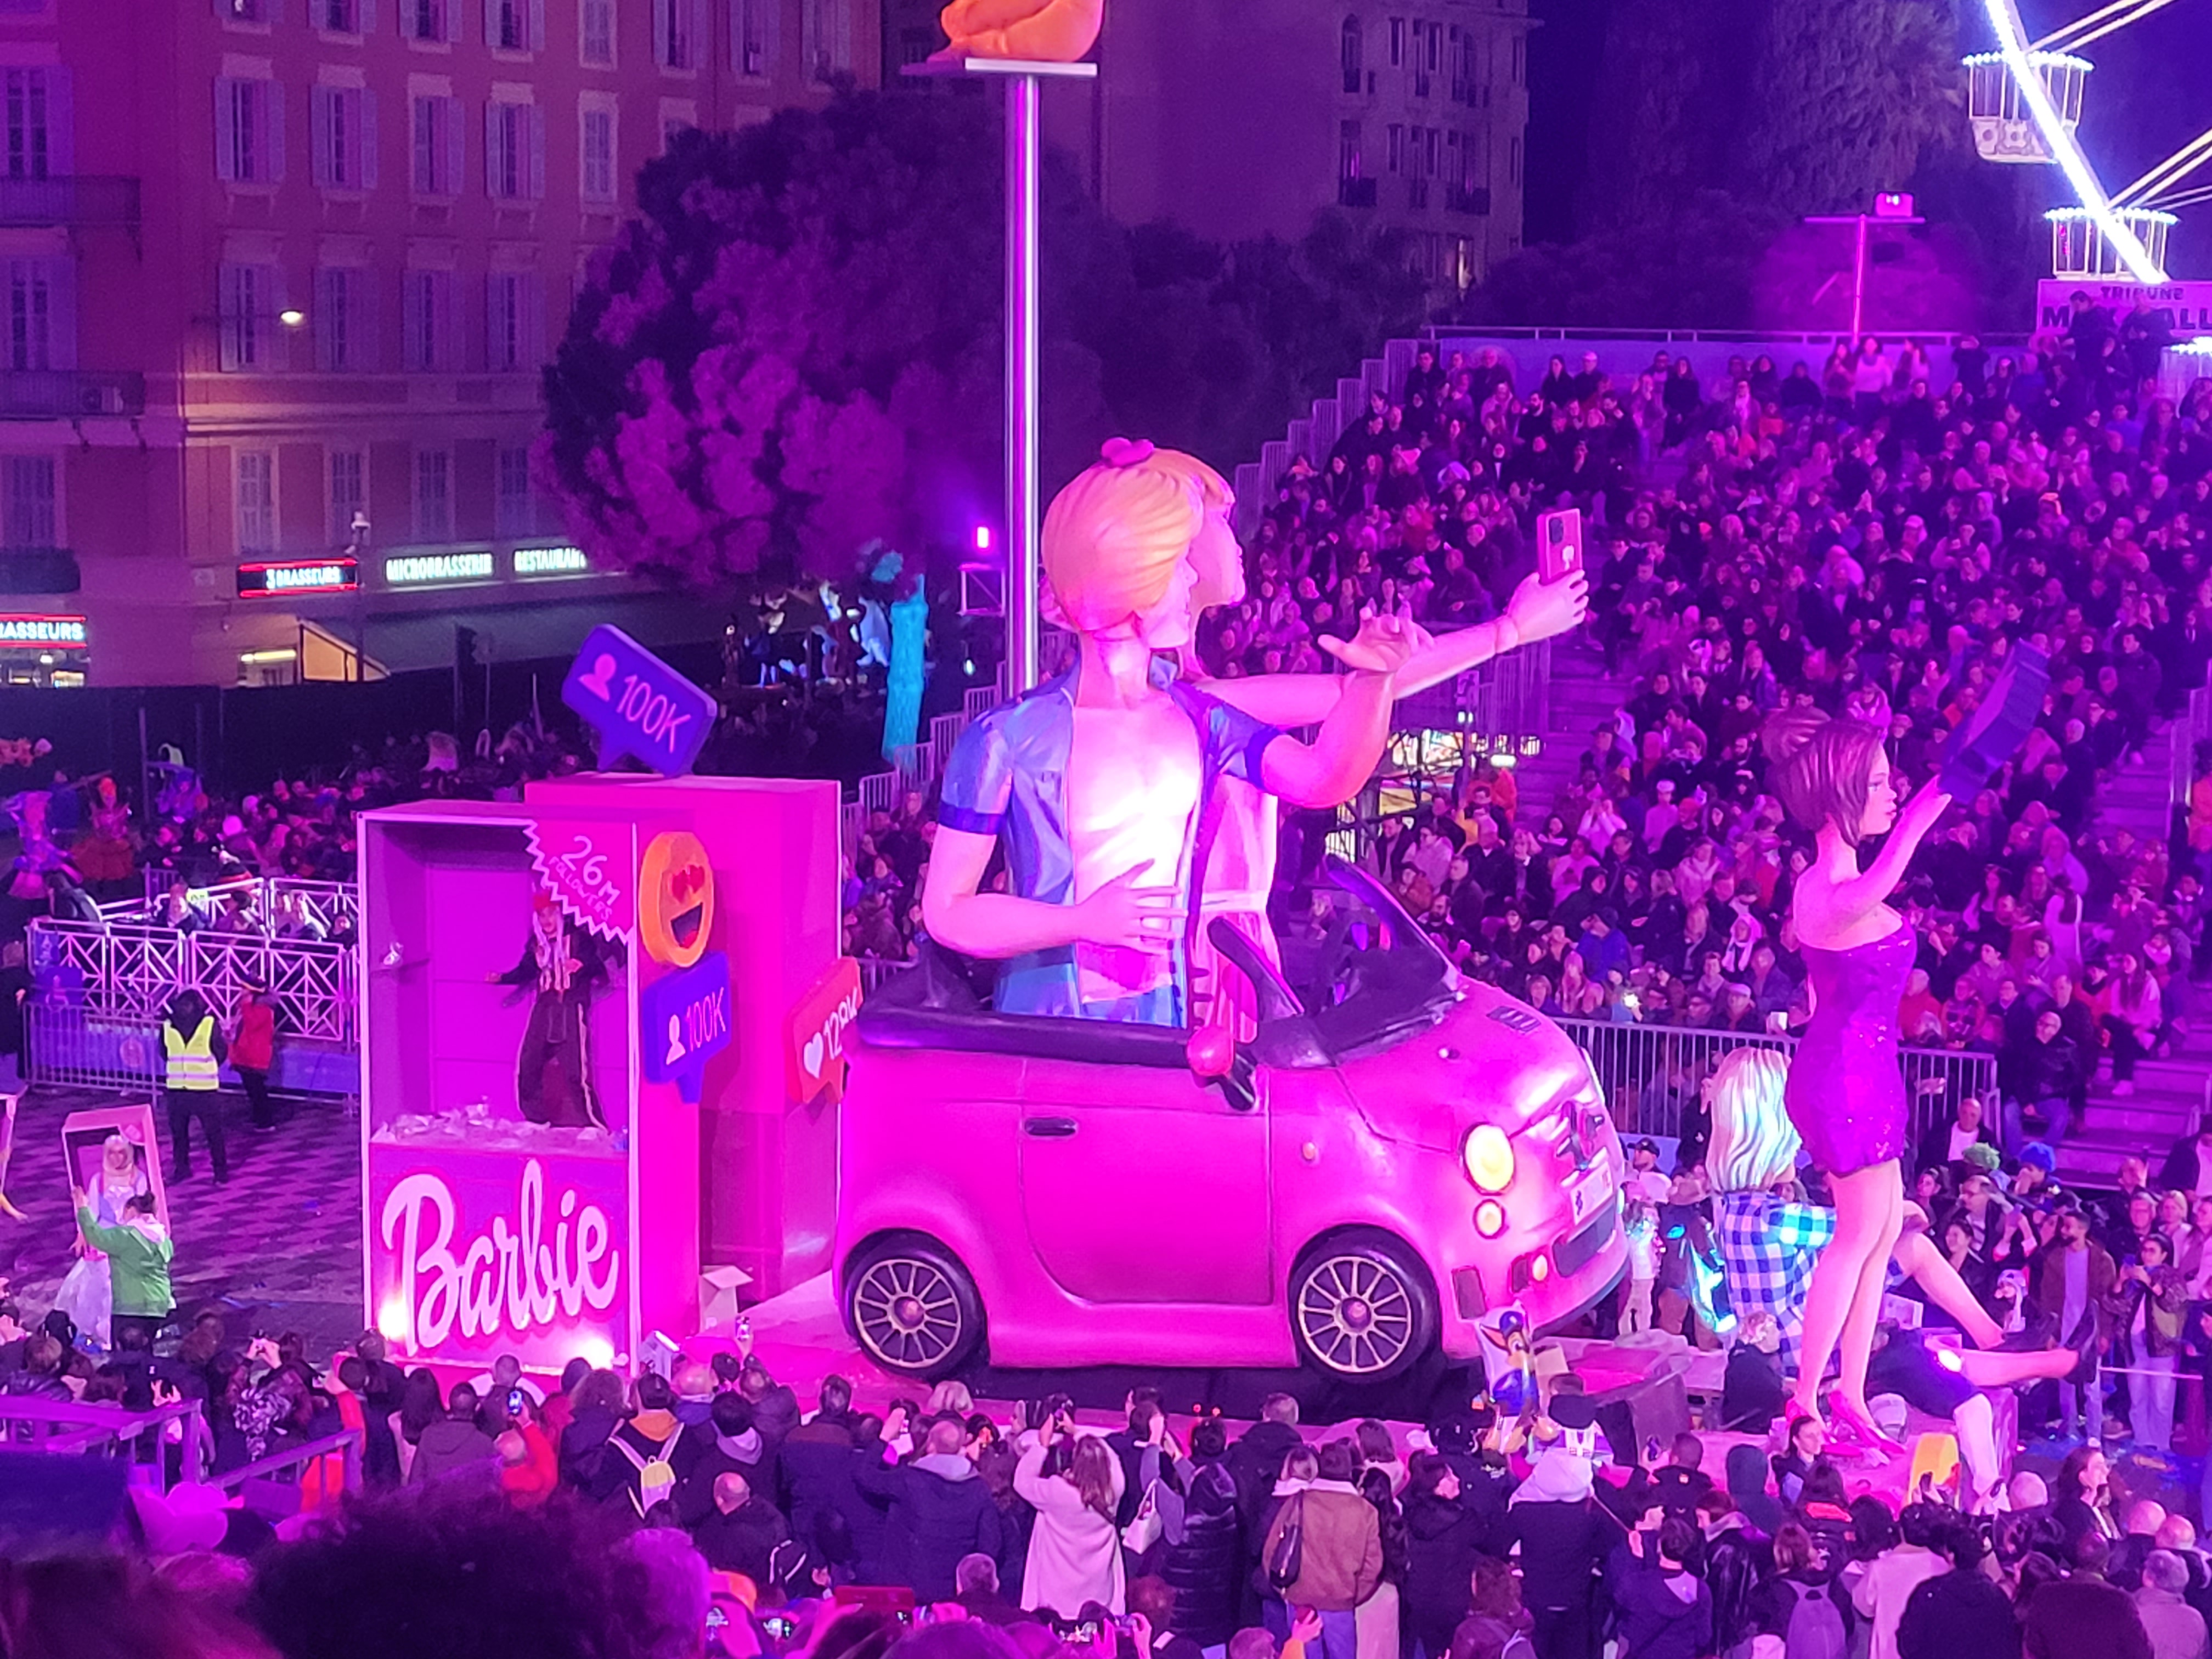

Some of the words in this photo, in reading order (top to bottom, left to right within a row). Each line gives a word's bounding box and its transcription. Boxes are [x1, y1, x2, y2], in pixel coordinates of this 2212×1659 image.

[386, 552, 493, 582] MICROBRASSERIE
[616, 674, 691, 754] 100K
[685, 986, 727, 1053] 100K
[381, 1158, 619, 1357] Barbie
